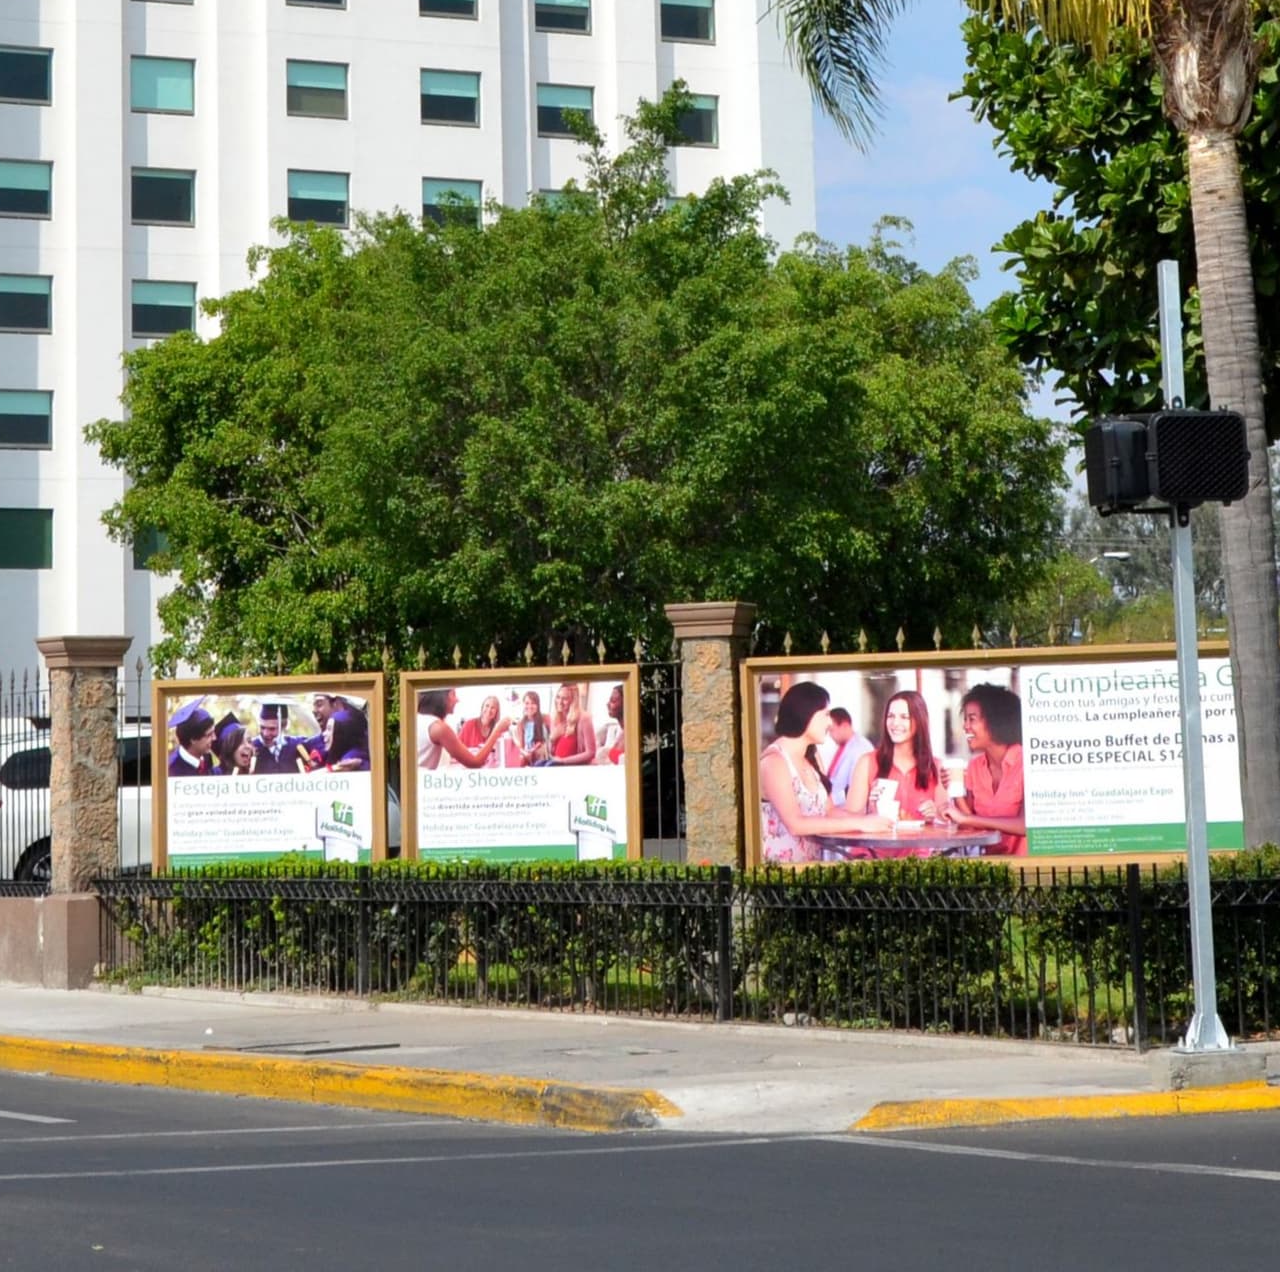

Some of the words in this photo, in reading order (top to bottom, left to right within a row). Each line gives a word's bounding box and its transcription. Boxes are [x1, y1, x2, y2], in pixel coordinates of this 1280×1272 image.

[1028, 668, 1207, 698] ¡Cumpleañea
[1053, 699, 1075, 708] con
[1078, 698, 1096, 708] tus
[1099, 694, 1141, 707] amigas
[1143, 695, 1150, 706] y
[1085, 711, 1100, 721] La
[1205, 707, 1227, 718] por
[1030, 737, 1101, 751] Desayuno
[1105, 733, 1149, 747] Buffet
[1153, 732, 1171, 745] de
[1227, 733, 1236, 743] a
[1030, 752, 1083, 765] PRECIO
[1087, 750, 1156, 764] ESPECIAL
[174, 780, 229, 798] Festeja
[235, 781, 251, 794] tu
[256, 775, 350, 794] Graduación
[423, 773, 463, 791] Baby
[468, 771, 539, 788] Showers
[1031, 789, 1067, 799] Holiday
